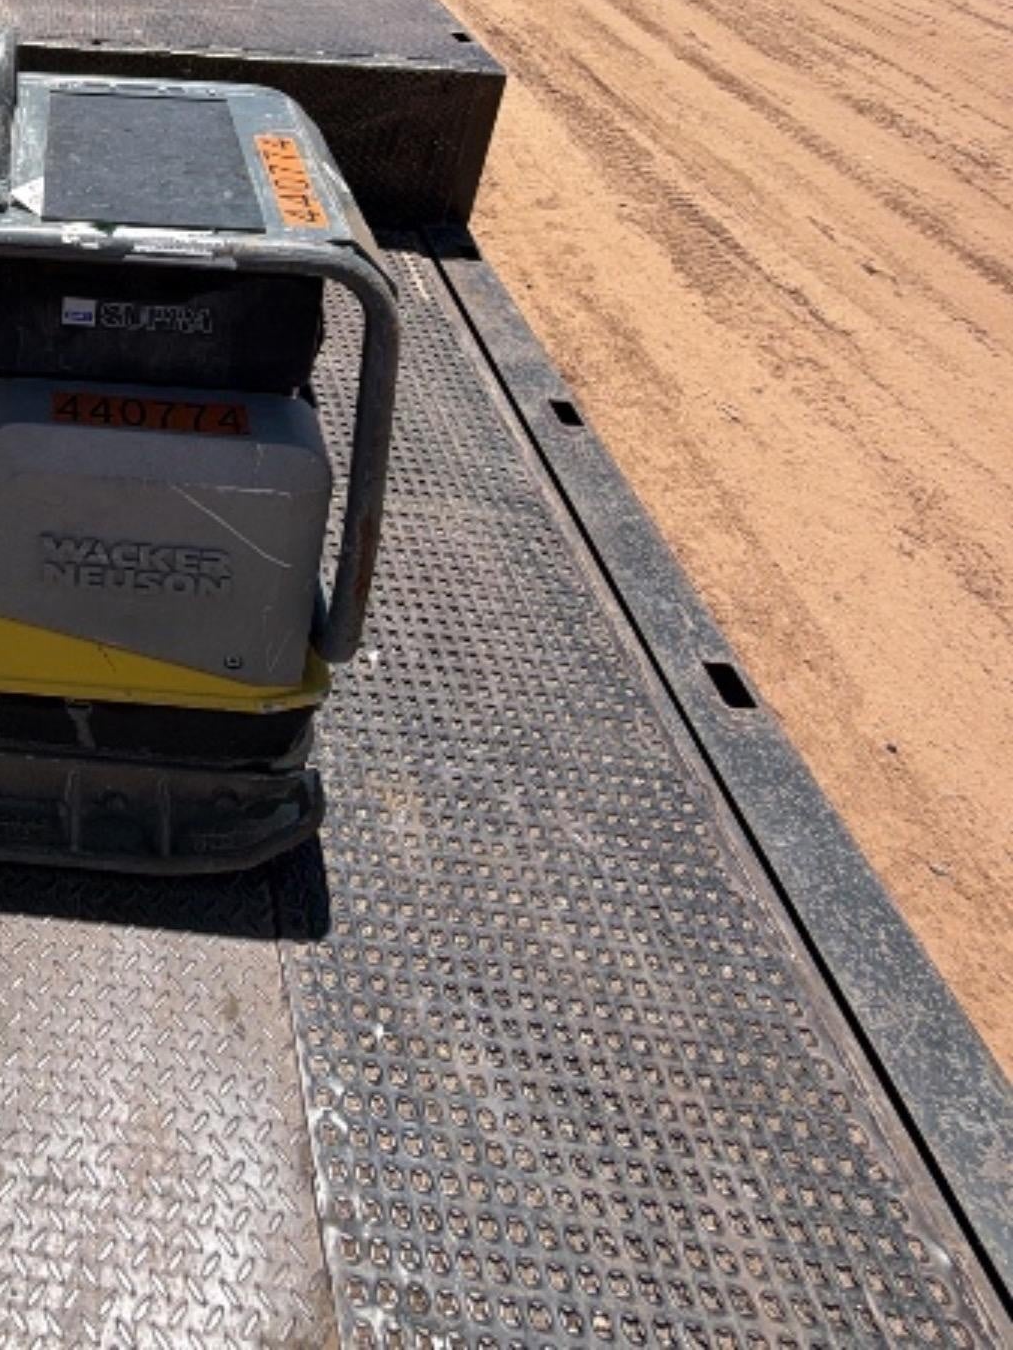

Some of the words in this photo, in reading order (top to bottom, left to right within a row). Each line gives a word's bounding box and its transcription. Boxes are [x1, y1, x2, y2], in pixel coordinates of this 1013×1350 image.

[55, 394, 241, 435] 440774
[41, 531, 231, 575] WACKER
[43, 561, 230, 597] NEUSON
